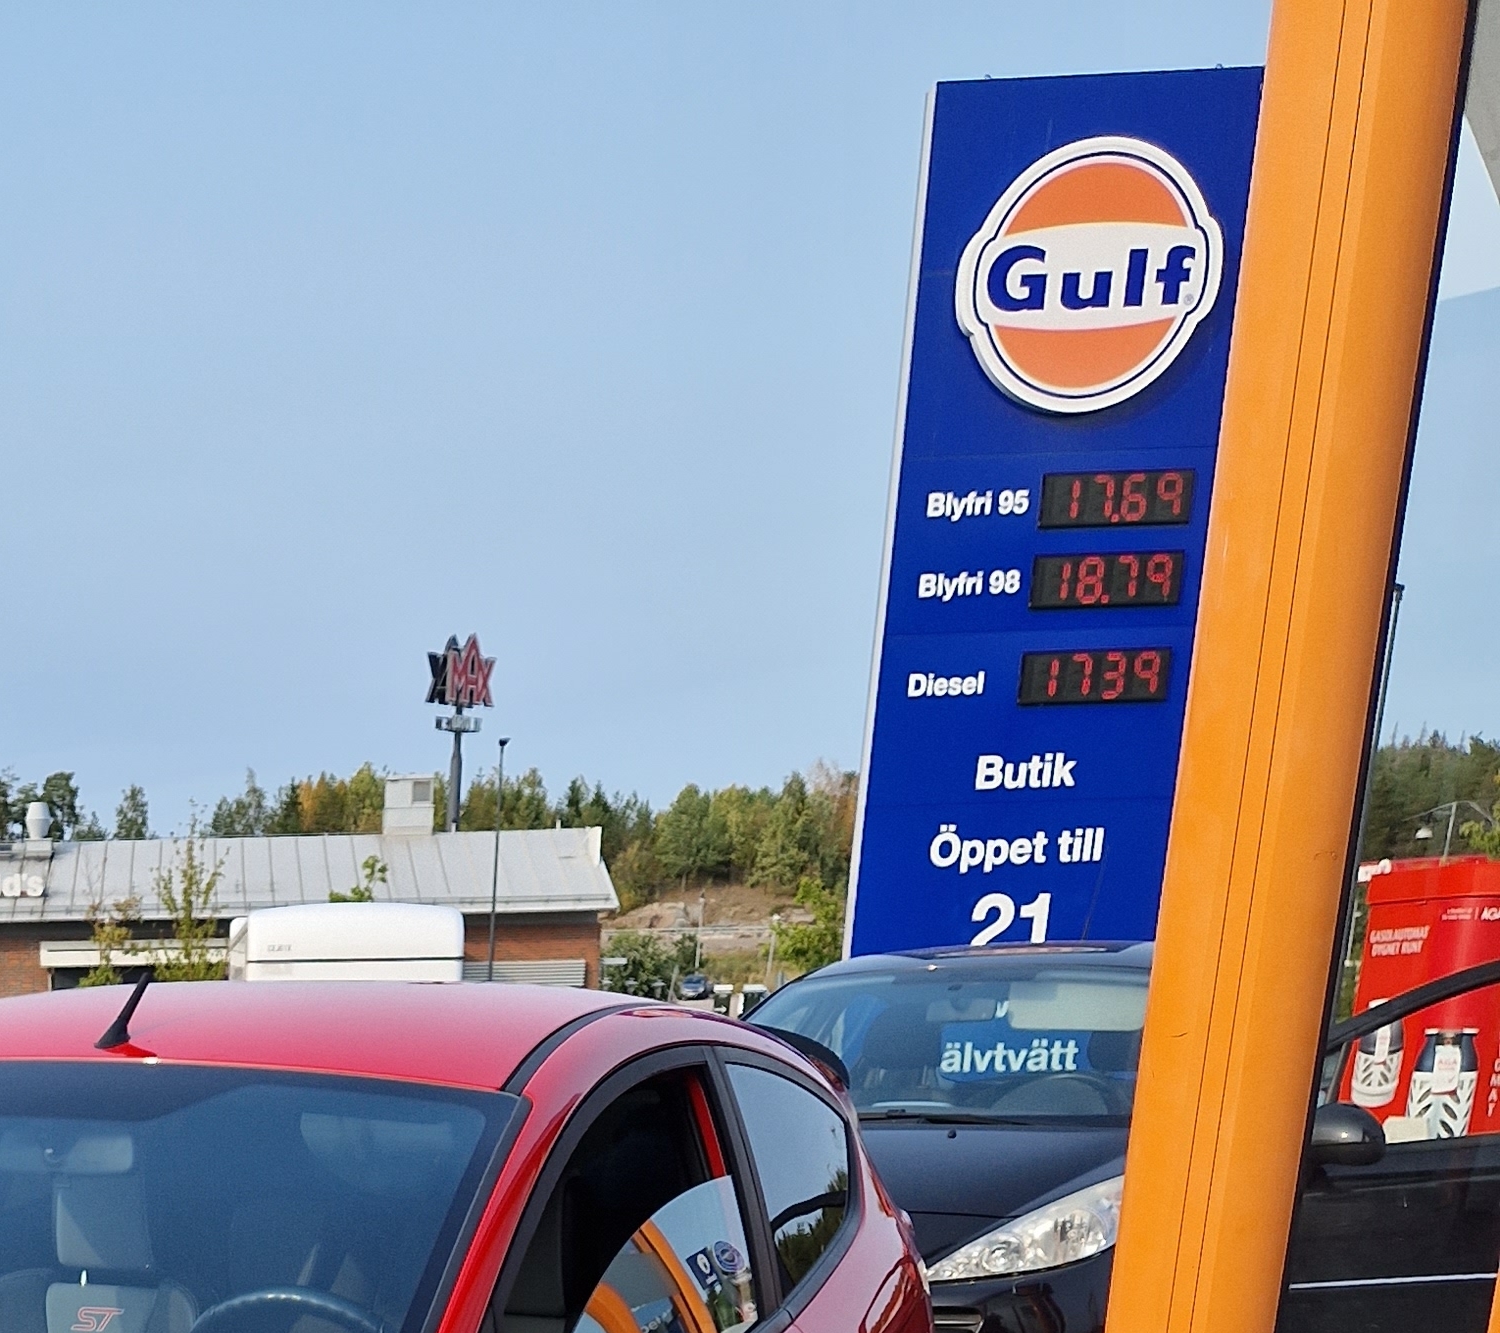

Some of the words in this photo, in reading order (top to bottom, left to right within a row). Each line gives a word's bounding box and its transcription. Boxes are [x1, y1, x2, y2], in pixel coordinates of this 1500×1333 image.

[987, 244, 1196, 312] Gulf
[926, 490, 992, 521] Blyfri
[998, 489, 1030, 514] 95
[1069, 472, 1184, 522] 17.69
[918, 571, 984, 602] Blyfri
[988, 569, 1021, 595] 98
[1059, 553, 1173, 604] 18.79
[444, 632, 497, 708] MAX
[907, 671, 985, 697] Diesel
[975, 752, 1077, 790] Butik
[930, 824, 1049, 874] Öppet
[1058, 827, 1104, 863] till
[970, 892, 1051, 946] 21
[940, 1038, 1079, 1074] älvtvätt
[70, 1306, 125, 1332] ST
